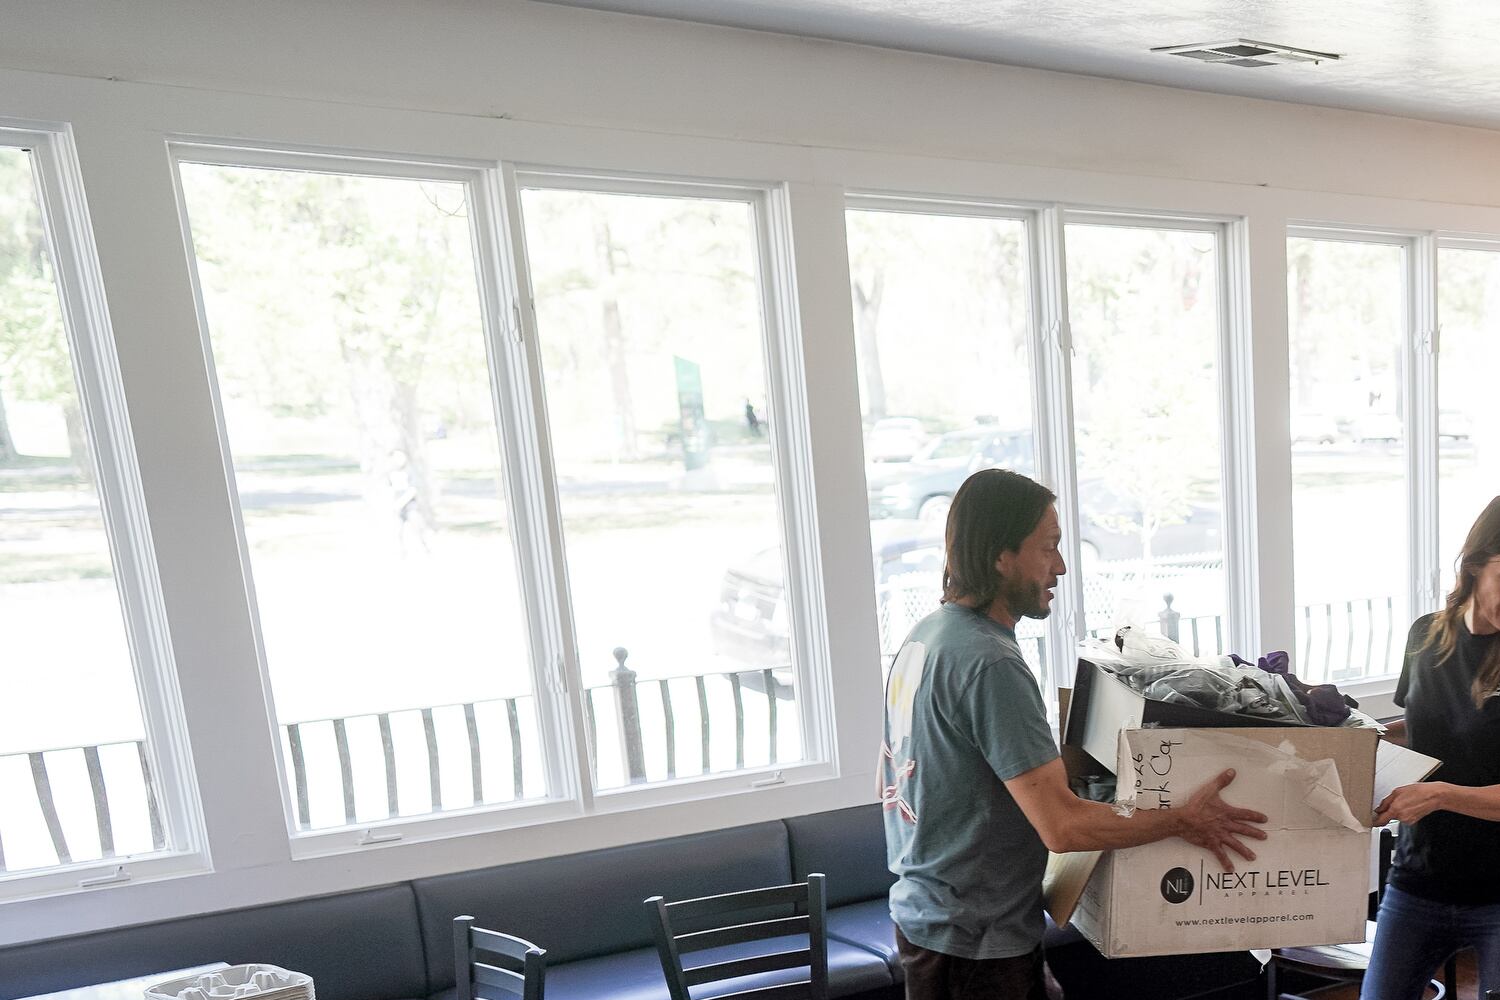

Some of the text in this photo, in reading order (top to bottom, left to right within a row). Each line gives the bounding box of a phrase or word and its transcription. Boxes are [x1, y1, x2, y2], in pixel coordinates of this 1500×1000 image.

[1166, 877, 1189, 896] NL
[1206, 869, 1329, 890] NEXT LEVEL
[1223, 889, 1310, 898] APPAREL
[1175, 912, 1315, 928] www.nextlevelapparel.com
